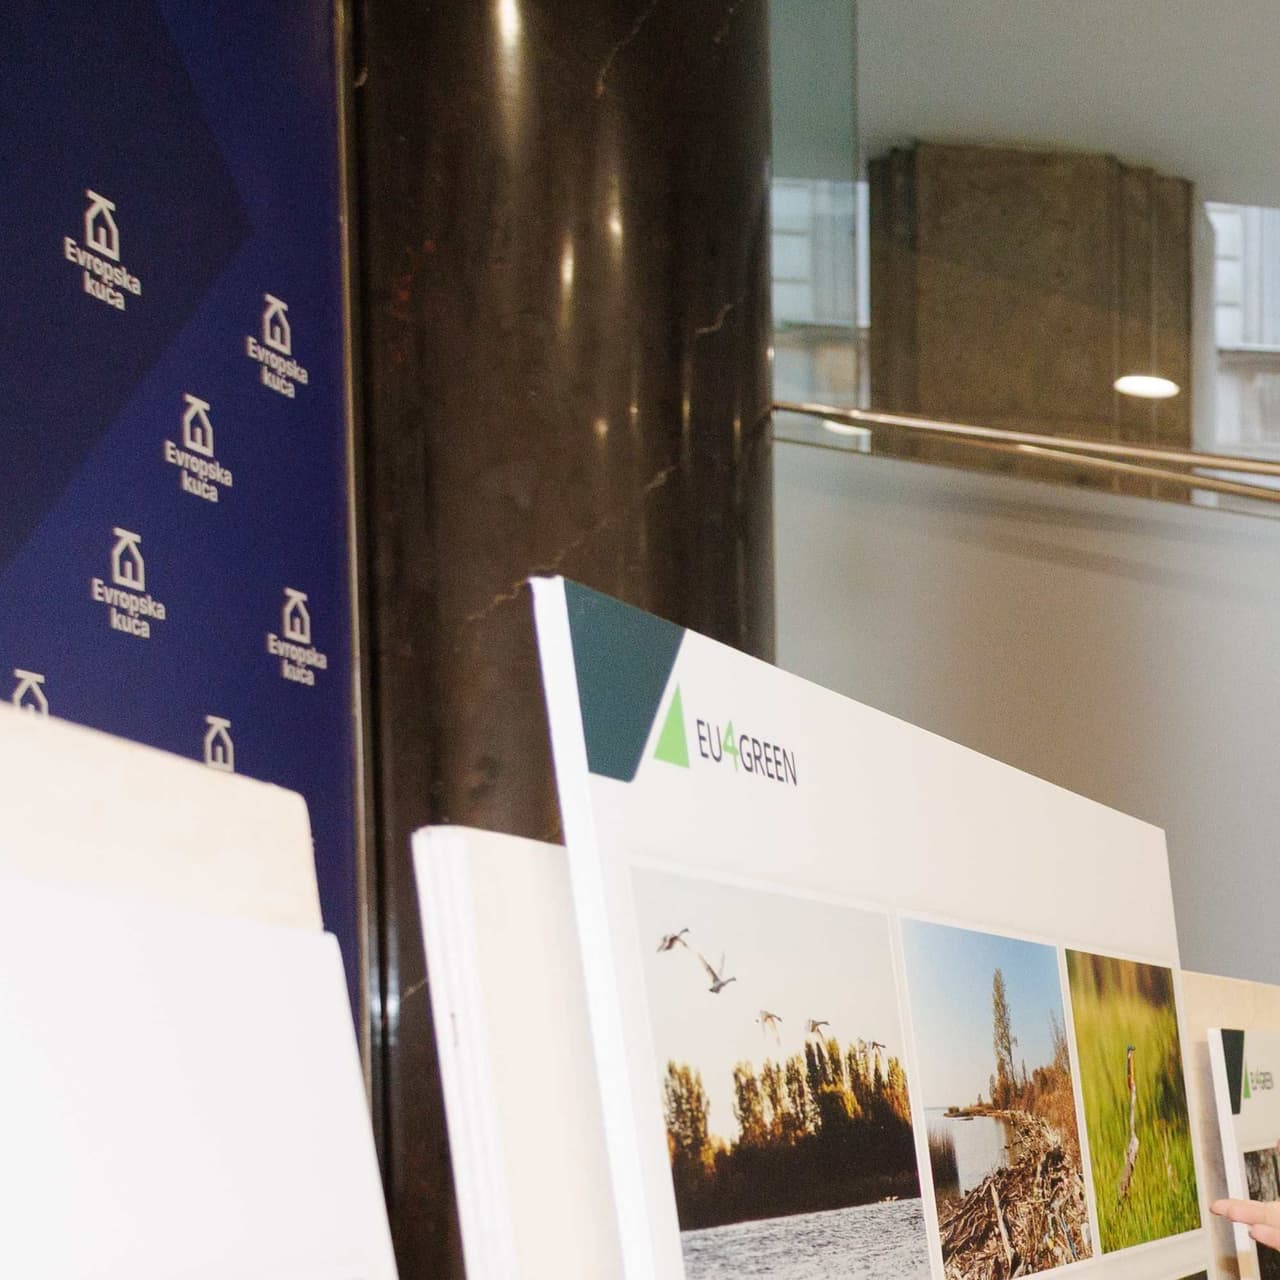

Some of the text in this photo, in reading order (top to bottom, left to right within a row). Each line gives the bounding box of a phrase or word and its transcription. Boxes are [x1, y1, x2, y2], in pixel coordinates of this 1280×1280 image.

[64, 236, 141, 295] Evropska
[84, 270, 126, 311] kuća
[247, 336, 308, 384] Evropska
[262, 366, 295, 398] kuća
[165, 440, 232, 487] Evropska
[182, 469, 218, 502] kuća
[92, 578, 166, 620] Evropska
[110, 607, 150, 638] kuća
[267, 633, 327, 669] Evropska
[696, 719, 798, 786] EU4GREEN
